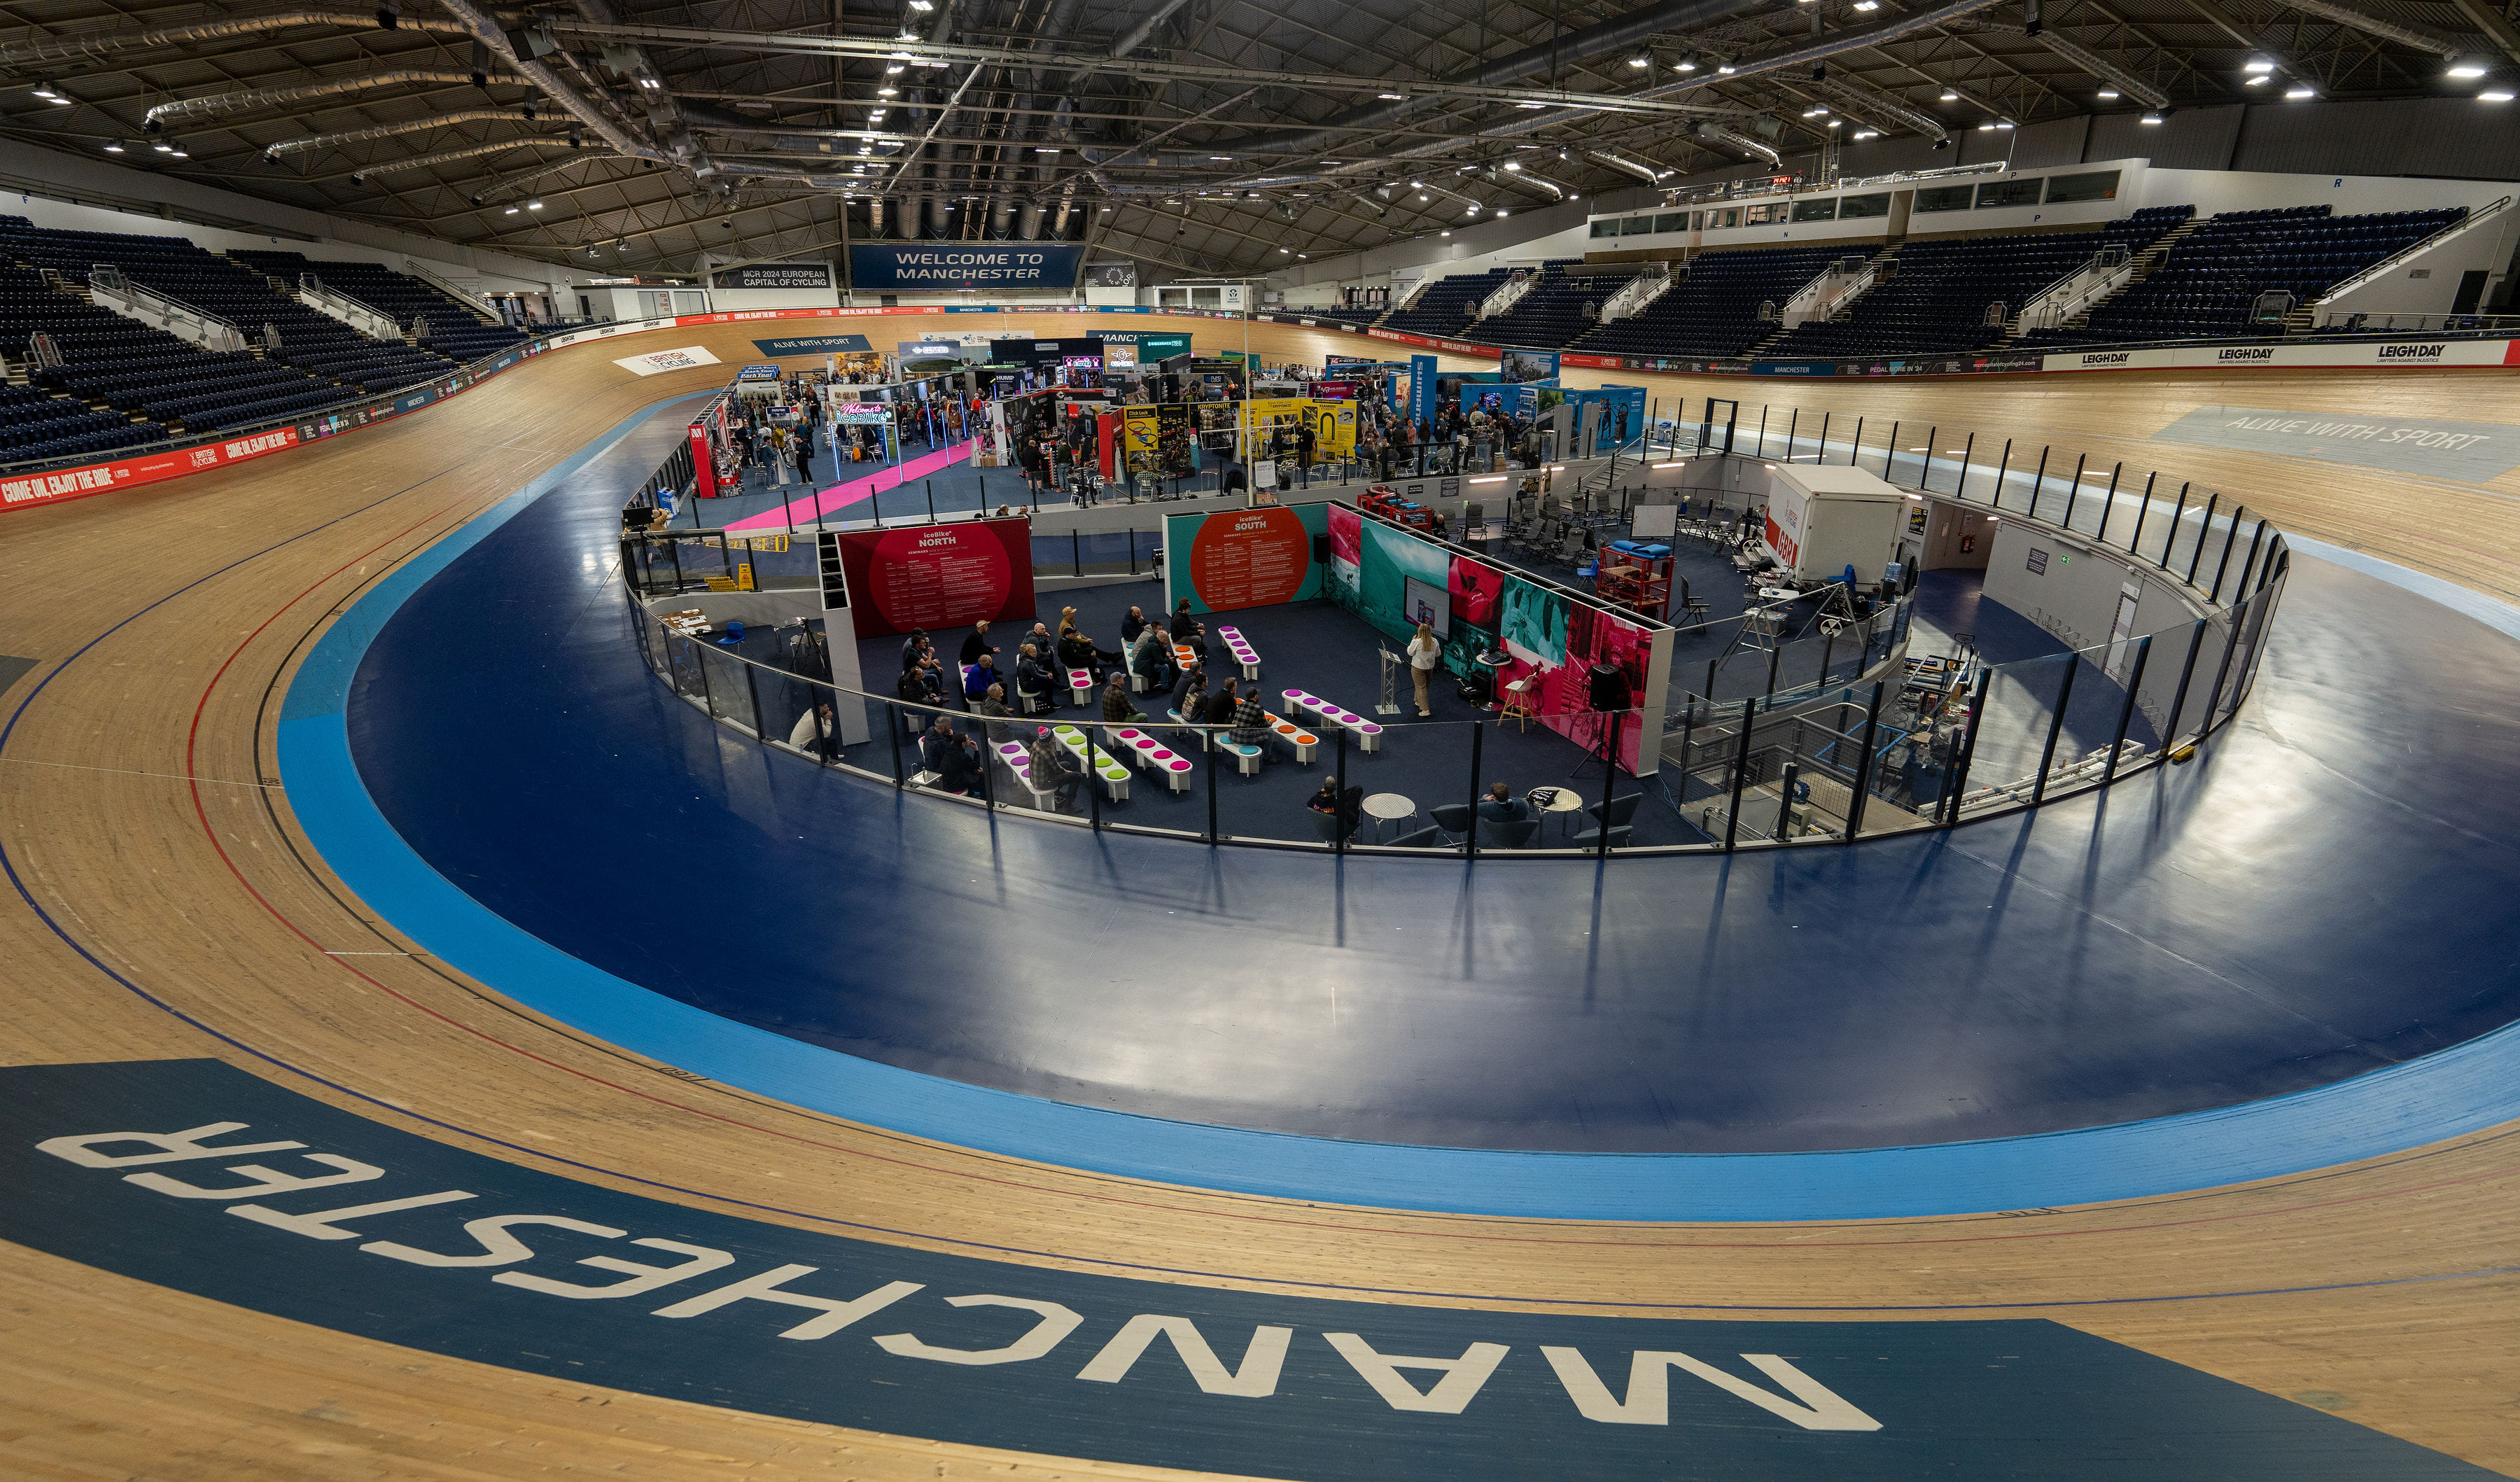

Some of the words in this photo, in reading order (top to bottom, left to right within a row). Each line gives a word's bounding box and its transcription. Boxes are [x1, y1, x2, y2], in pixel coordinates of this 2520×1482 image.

[2334, 179, 2342, 188] R
[896, 253, 1010, 265] WELCOME
[1016, 253, 1043, 265] TO
[896, 268, 1041, 279] MANCHESTER
[773, 340, 799, 349] ALIVE
[649, 351, 686, 363] BRITISH
[2218, 349, 2251, 360] LEIGH
[2252, 348, 2275, 358] DAY
[2379, 345, 2418, 358] LEIGH
[2418, 344, 2446, 357] DAY
[659, 357, 696, 371] CYCLING
[2082, 354, 2110, 364] LEIGH
[2110, 353, 2131, 363] DAY
[1415, 361, 1424, 426] SHIMANO
[407, 396, 425, 407] MANCHESTER
[840, 403, 874, 416] Welcome
[836, 410, 887, 423] iceBike
[319, 424, 331, 433] PEDAL
[1013, 423, 1022, 435] FIST
[2225, 417, 2299, 434] ALIVE
[2304, 420, 2384, 441] WITH
[2377, 428, 2490, 452] SPORT
[225, 442, 244, 459] COME
[241, 439, 253, 456] ON,
[251, 435, 269, 453] ENJOY
[266, 434, 278, 449] THE
[274, 432, 288, 447] RIDE
[195, 448, 216, 459] BRITISH
[198, 456, 218, 466] CYCLING
[1, 480, 34, 503] COME
[31, 477, 52, 498] ON,
[47, 473, 79, 495] ENJOY
[76, 470, 95, 490] THE
[92, 468, 114, 487] RIDE
[1234, 521, 1266, 531] SOUTH
[918, 536, 956, 547] NORTH
[1778, 530, 1793, 566] GBR
[35, 1120, 1884, 1432] MANCHESTER
